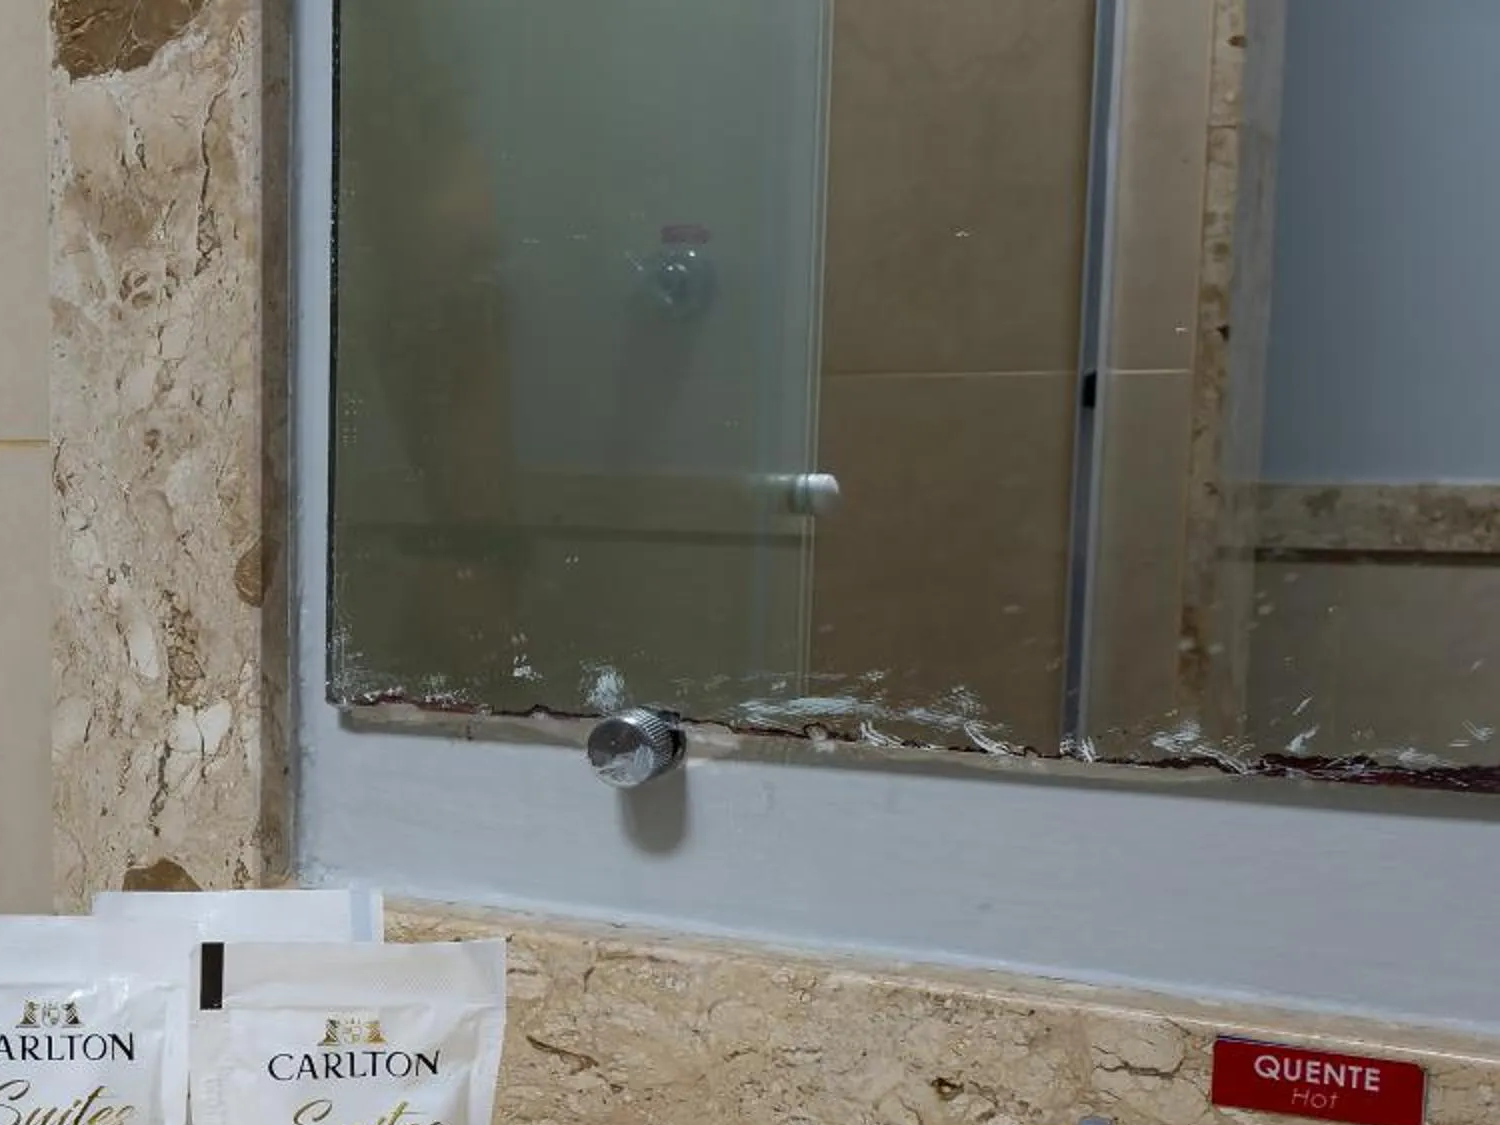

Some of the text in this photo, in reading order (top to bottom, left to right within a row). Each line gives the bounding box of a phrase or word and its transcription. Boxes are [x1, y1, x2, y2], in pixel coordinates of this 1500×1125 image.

[267, 1048, 440, 1082] CARLTON
[1253, 1054, 1381, 1092] QUENTE
[1291, 1087, 1340, 1110] Hot
